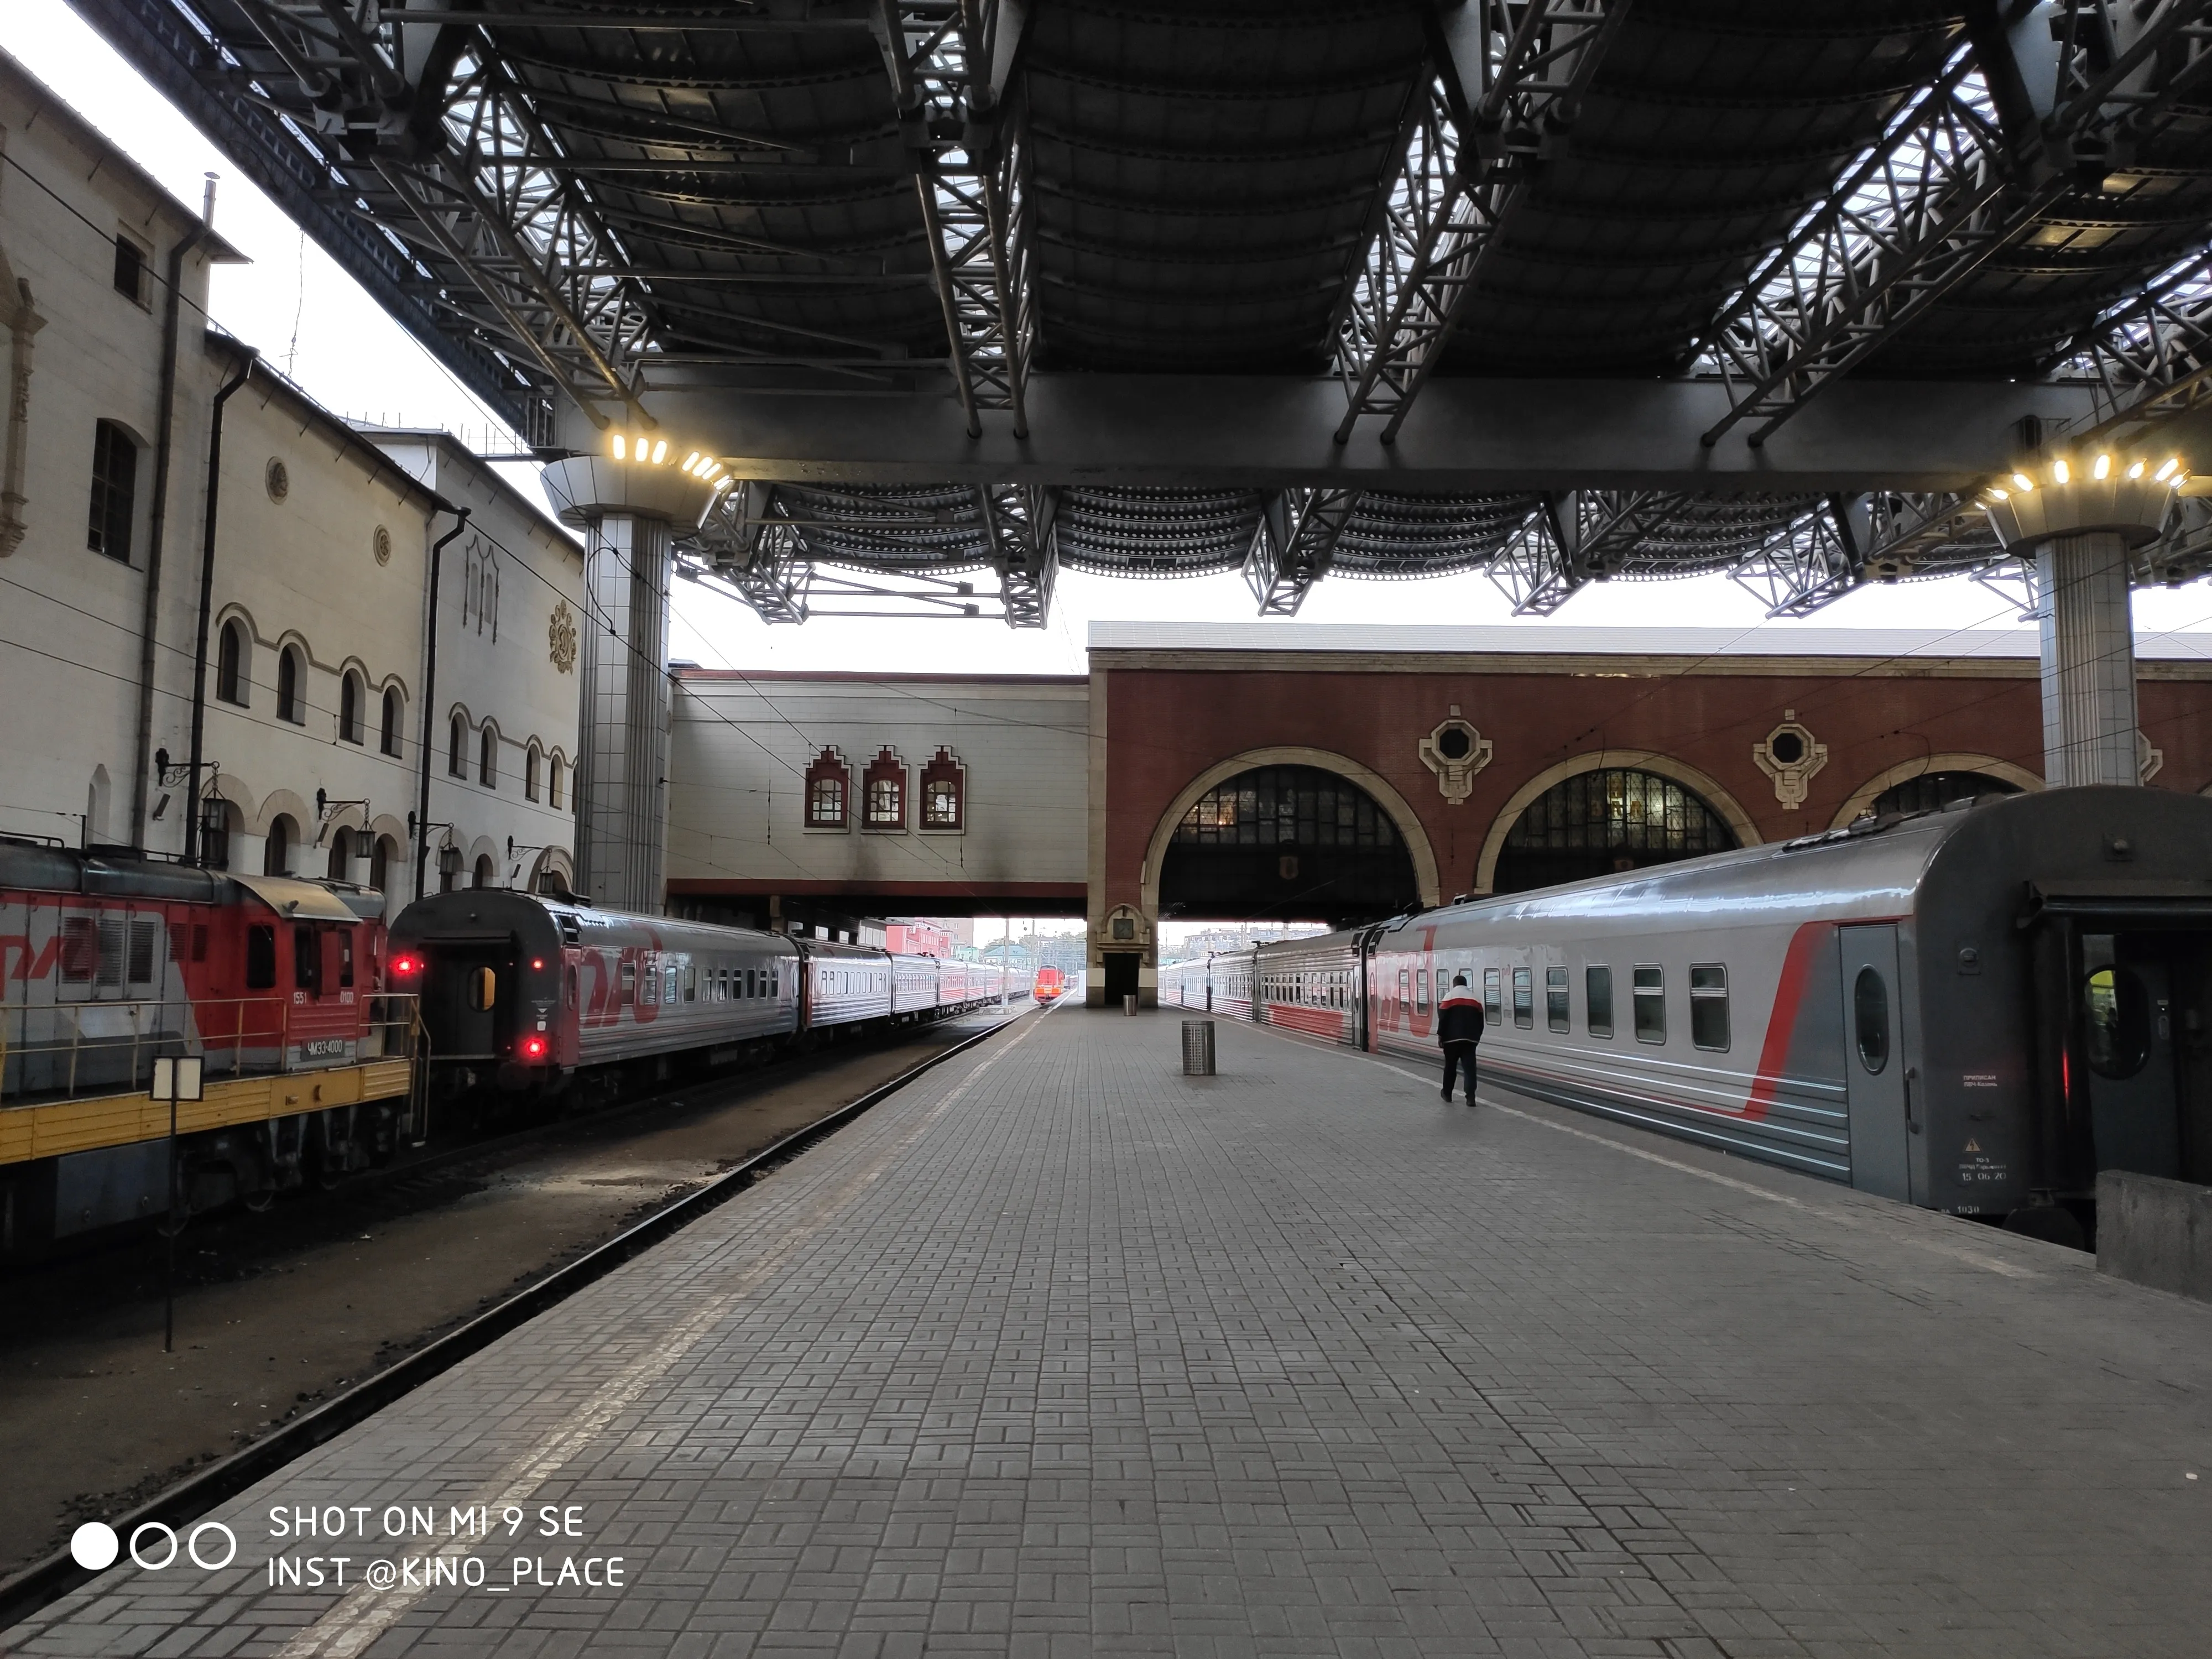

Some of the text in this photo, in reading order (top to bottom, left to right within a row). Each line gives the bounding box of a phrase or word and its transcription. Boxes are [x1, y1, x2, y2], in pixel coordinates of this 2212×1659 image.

[293, 991, 354, 1004] 1551 0100
[1994, 1172, 2007, 1180] 20
[1957, 1206, 1979, 1214] 1030
